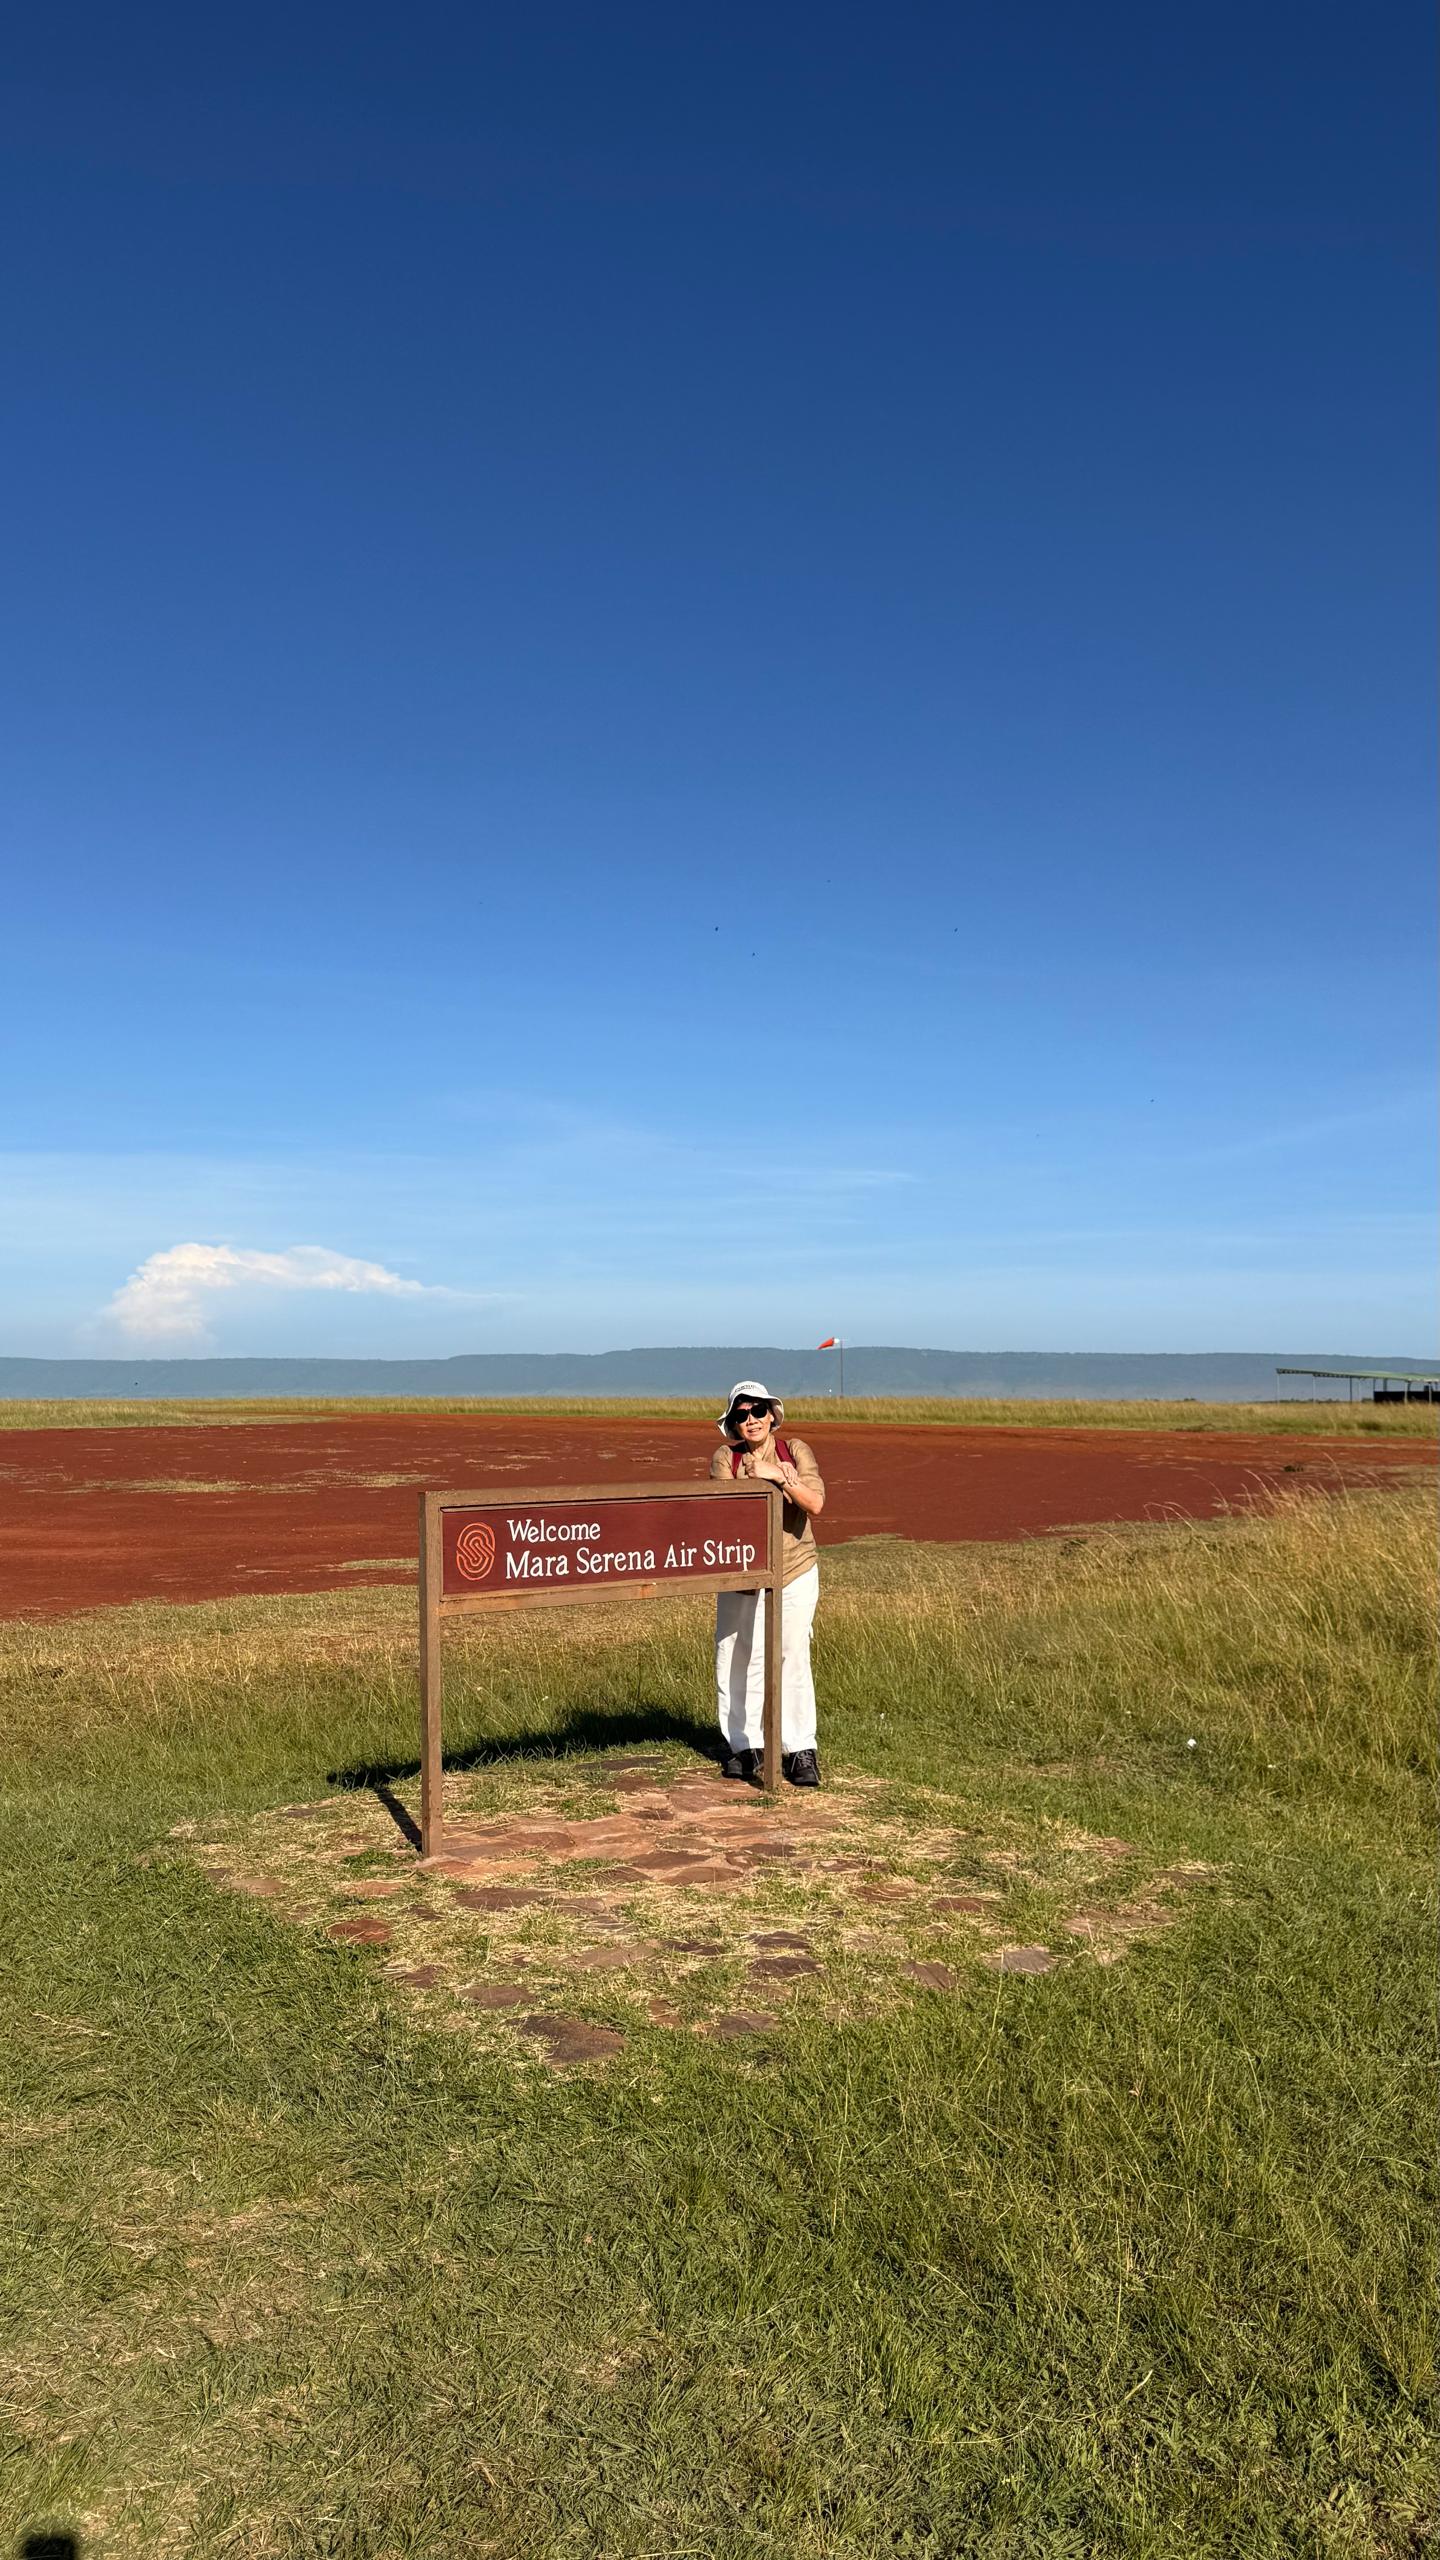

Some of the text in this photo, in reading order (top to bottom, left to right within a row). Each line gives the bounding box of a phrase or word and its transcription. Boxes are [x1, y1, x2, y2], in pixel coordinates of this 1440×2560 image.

[507, 1519, 600, 1543] Welcome
[506, 1539, 756, 1579] Mara Serena Air Strip
